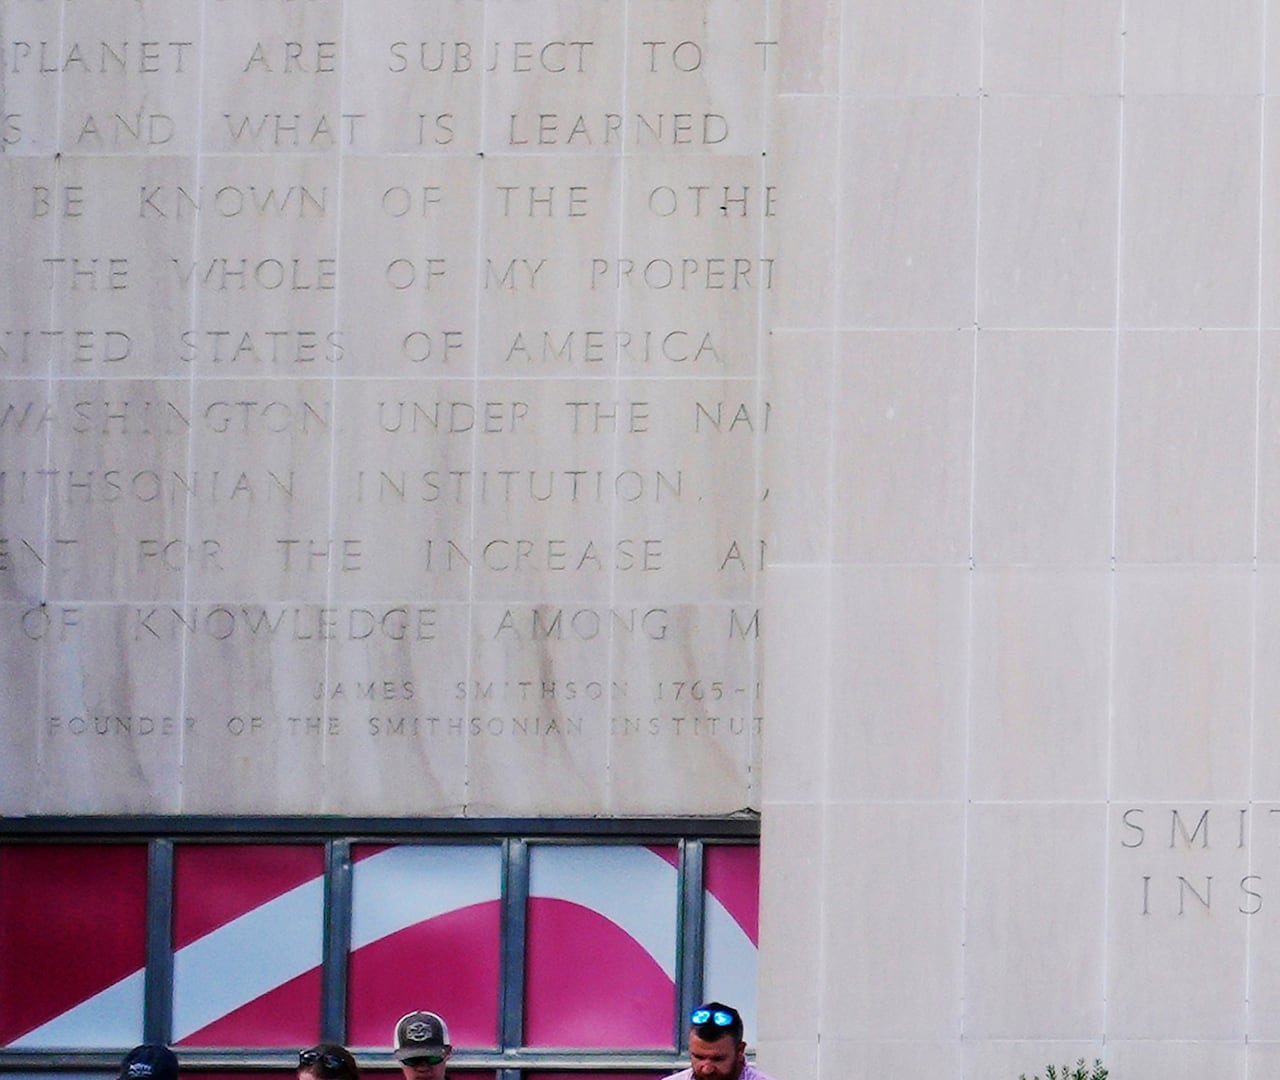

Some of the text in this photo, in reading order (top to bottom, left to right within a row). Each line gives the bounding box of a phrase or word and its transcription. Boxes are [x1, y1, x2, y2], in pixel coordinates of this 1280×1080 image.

[12, 41, 194, 74] PLANET
[243, 41, 337, 74] ARE
[388, 41, 595, 74] SUBJECT
[642, 41, 704, 74] TO
[77, 113, 175, 146] AND
[222, 113, 366, 146] WHAT
[418, 113, 454, 146] IS
[507, 113, 730, 146] LEARNED
[32, 186, 84, 219] BE
[138, 186, 330, 219] KNOWN
[382, 186, 441, 219] OF
[497, 186, 589, 219] THE
[42, 258, 129, 290] THE
[170, 258, 337, 290] WHOLE
[385, 258, 446, 290] OF
[484, 258, 548, 290] MY
[179, 330, 346, 363] STATES
[403, 330, 463, 363] OF
[504, 330, 724, 363] AMERICA
[377, 401, 529, 434] UNDER
[565, 401, 649, 434] THE
[0, 469, 296, 504] ITHSONIAN
[137, 538, 225, 572] FOR
[276, 538, 362, 572] THE
[425, 538, 663, 572] INCREASE
[21, 607, 79, 641] OF
[133, 607, 438, 641] KNOWLEDGE
[493, 607, 669, 641] AMONG
[312, 681, 415, 701] JAMES
[455, 681, 628, 701] SMITHSON
[48, 717, 199, 737] FOUNDER
[226, 717, 264, 737] OF
[288, 717, 341, 737] THE
[368, 717, 584, 737] SMITHSONIAN
